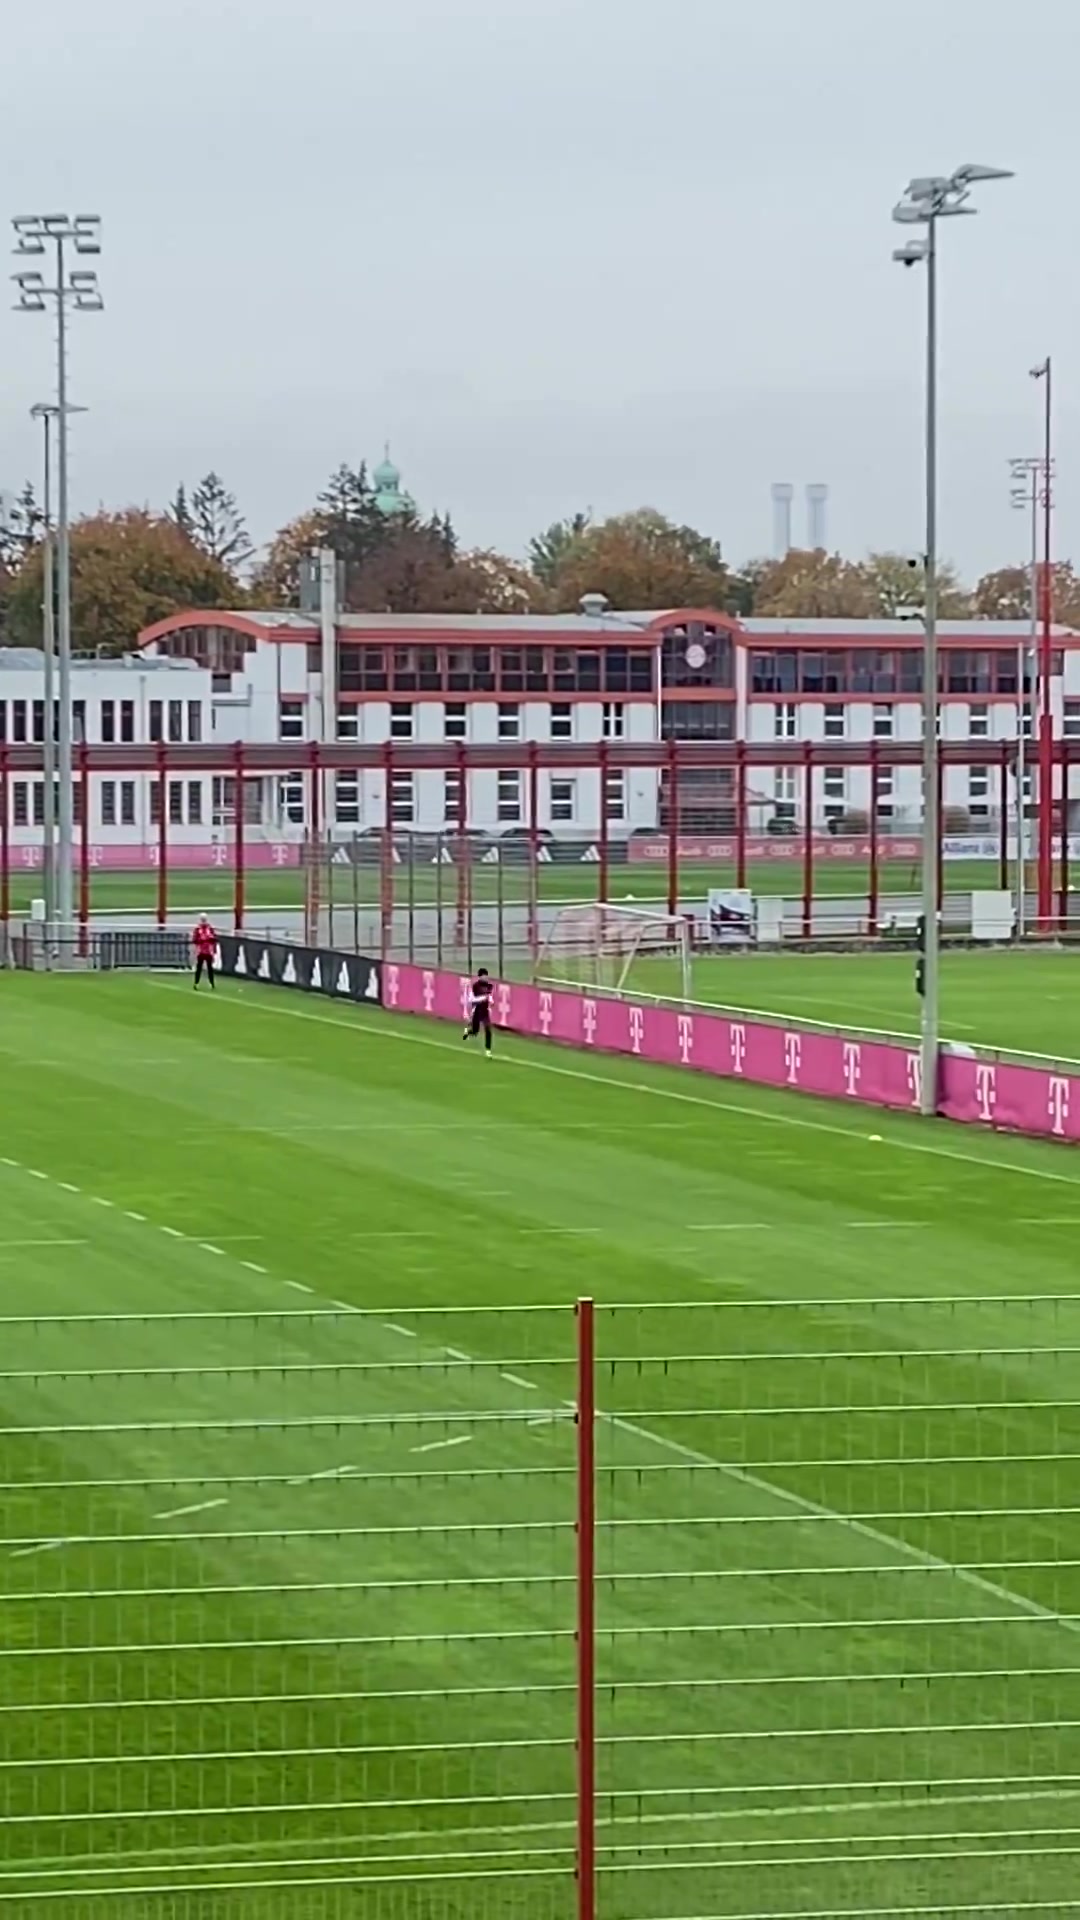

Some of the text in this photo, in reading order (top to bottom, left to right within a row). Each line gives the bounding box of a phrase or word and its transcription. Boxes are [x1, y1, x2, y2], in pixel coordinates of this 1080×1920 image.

[388, 965, 399, 1005] T
[423, 971, 434, 1011] T
[499, 984, 511, 1026] T
[540, 992, 552, 1035] T
[583, 999, 596, 1044] T
[629, 1007, 643, 1053] T
[678, 1015, 693, 1063] T
[730, 1023, 745, 1073] T
[785, 1032, 800, 1083] T
[843, 1043, 861, 1095] T
[976, 1065, 996, 1121] T
[1048, 1077, 1070, 1135] T
